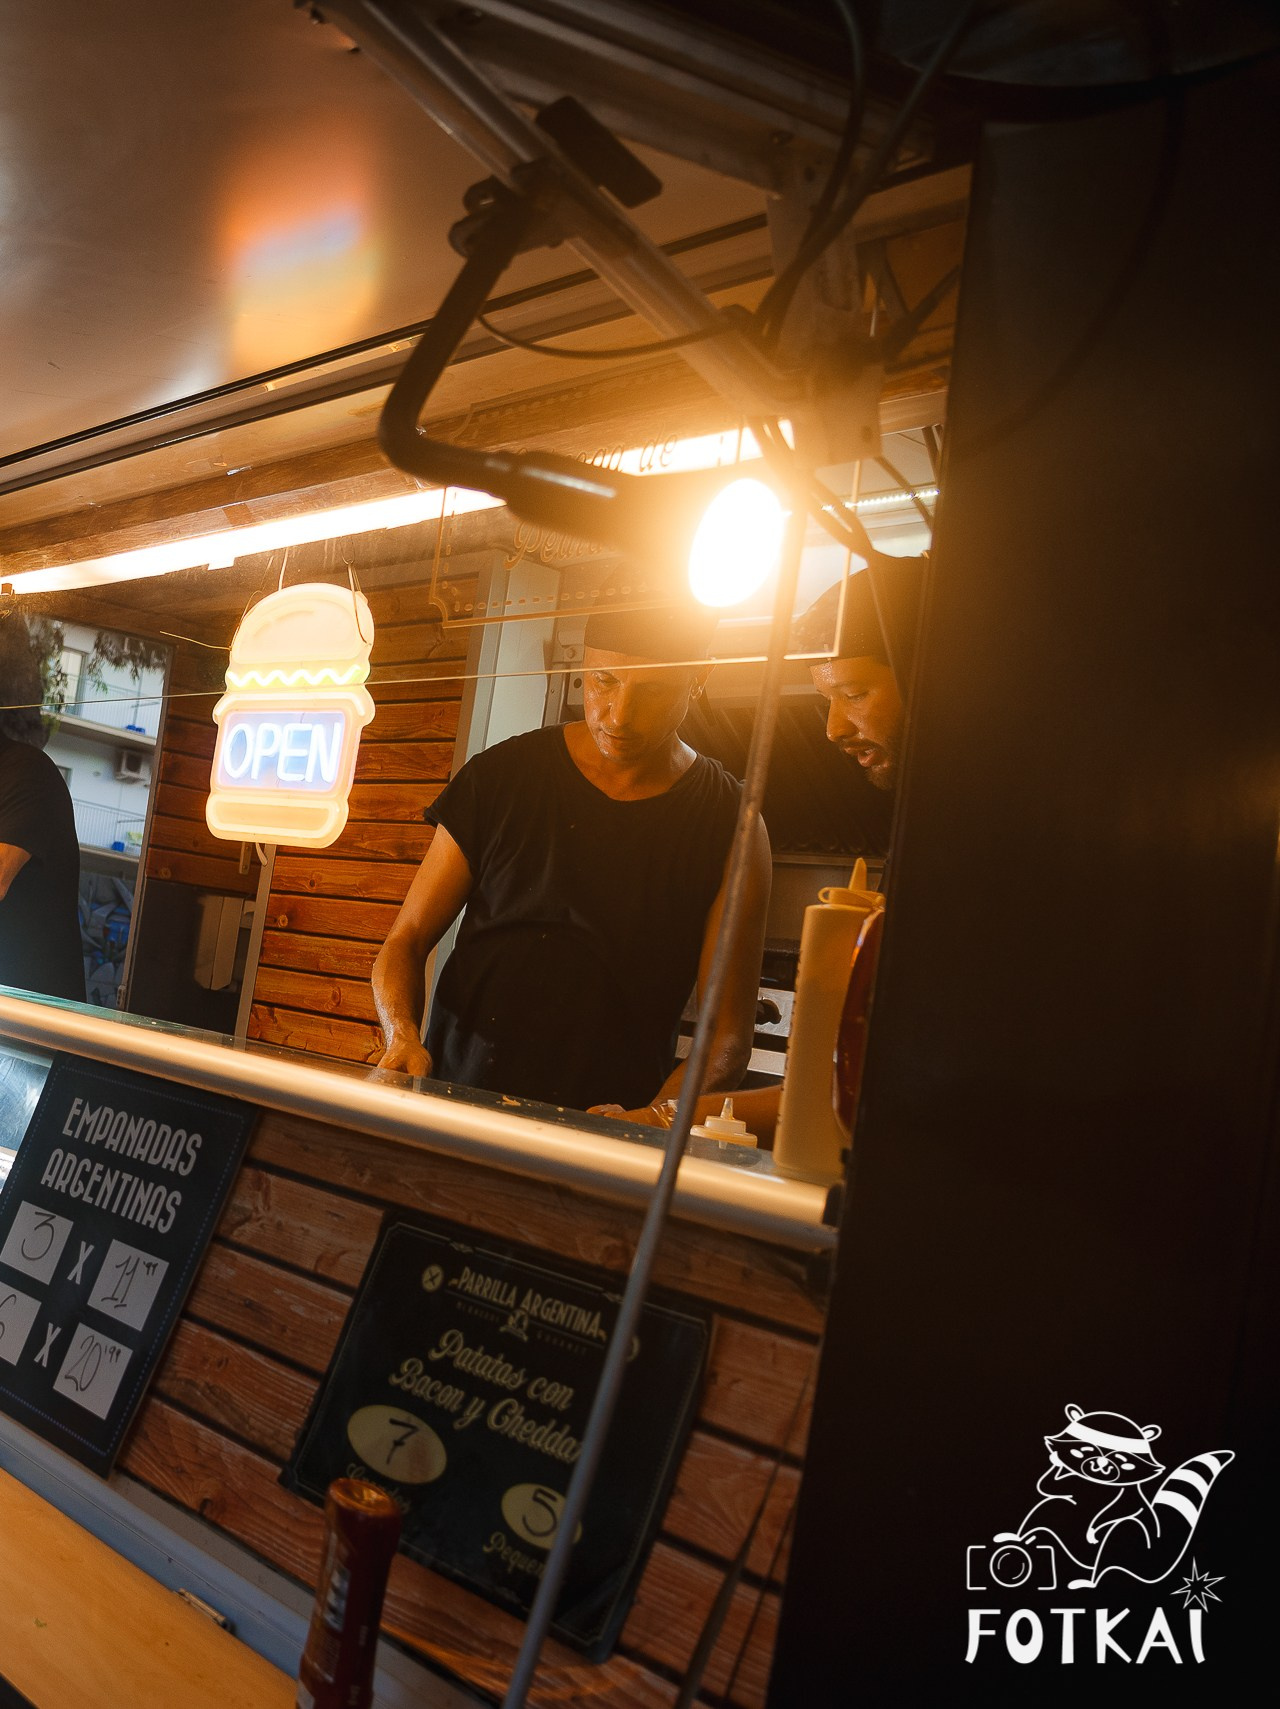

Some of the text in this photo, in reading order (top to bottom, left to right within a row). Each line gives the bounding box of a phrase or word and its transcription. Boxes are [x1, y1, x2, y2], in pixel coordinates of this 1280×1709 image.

[222, 722, 342, 783] OPEN
[61, 1097, 203, 1177] EMPANADAS
[40, 1148, 182, 1234] ARGENTINAS
[20, 1210, 57, 1262] 3
[456, 1265, 517, 1309] PARRILLA
[520, 1288, 602, 1339] ARGENTINA
[387, 1357, 466, 1413] Bacon
[452, 1395, 487, 1431] y
[427, 1328, 576, 1412] Patatas con
[386, 1416, 420, 1465] 7
[521, 1488, 558, 1537] 5
